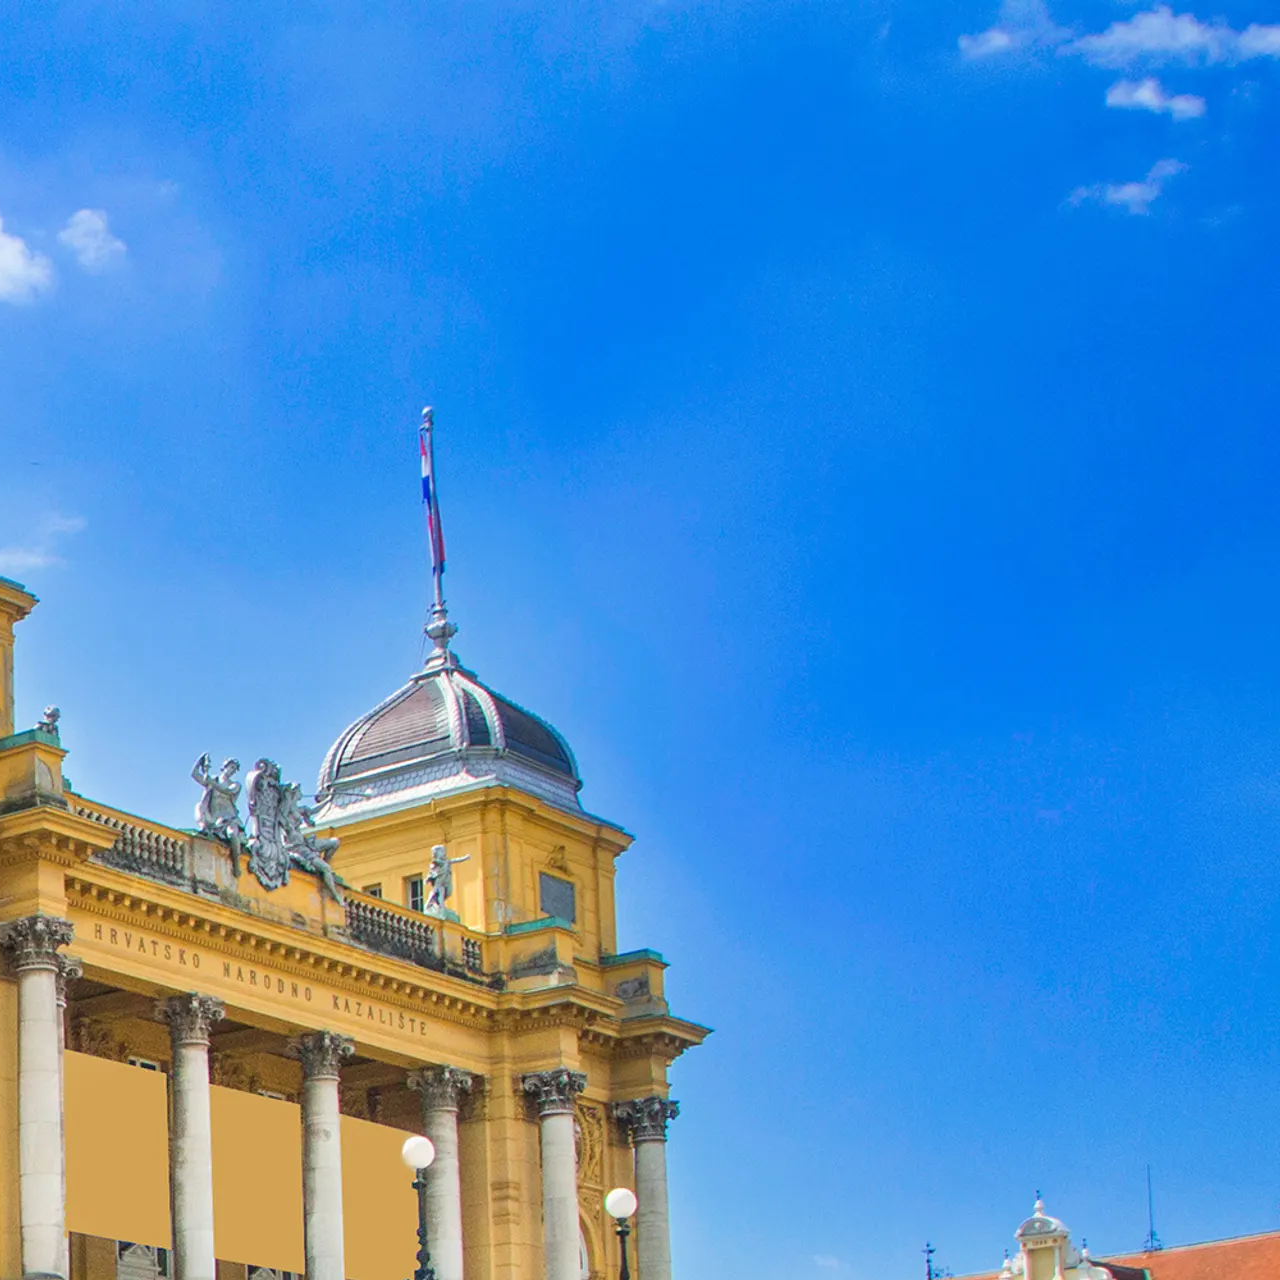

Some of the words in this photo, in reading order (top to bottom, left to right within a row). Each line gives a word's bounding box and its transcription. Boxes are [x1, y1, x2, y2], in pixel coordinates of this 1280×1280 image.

[94, 922, 200, 969] HRVATSKO
[223, 961, 313, 1002] NARODNO
[332, 994, 427, 1036] KAZALIŠTE
